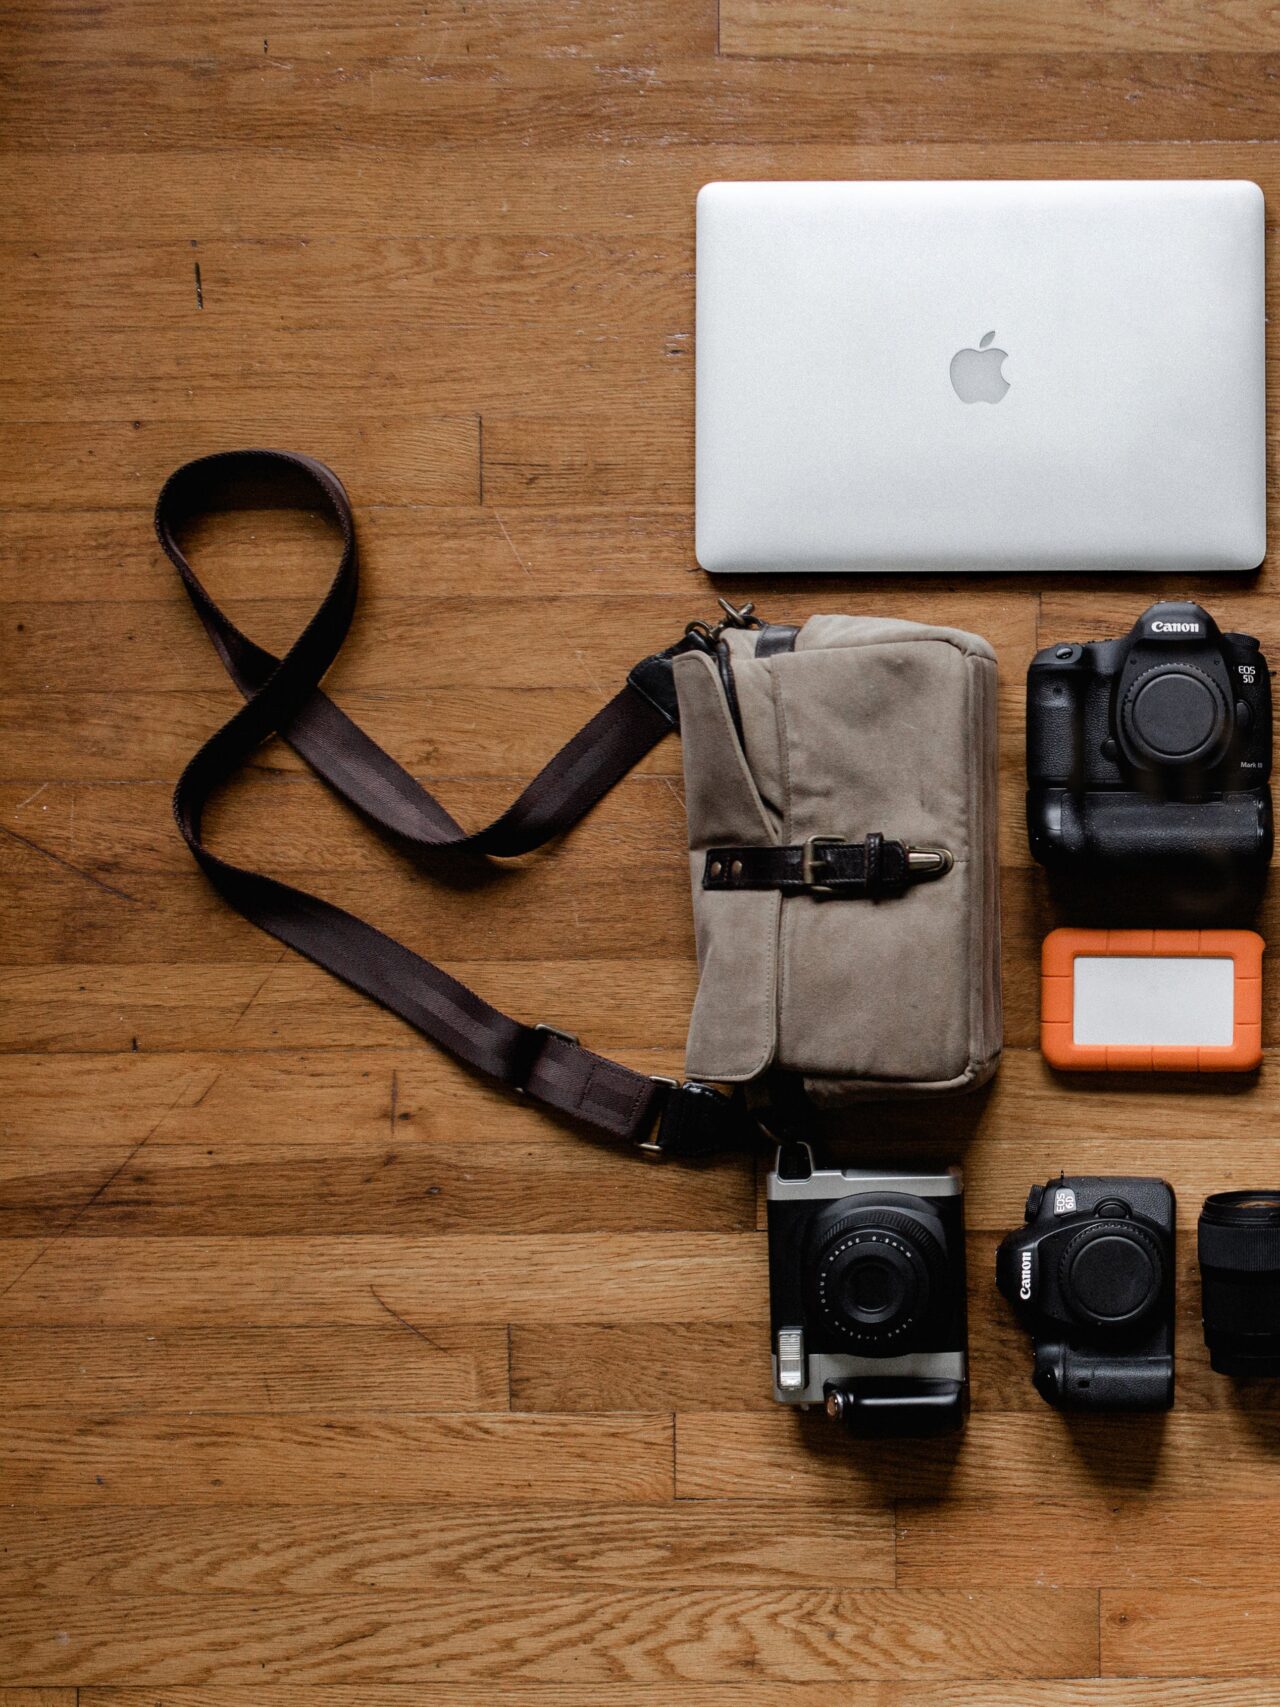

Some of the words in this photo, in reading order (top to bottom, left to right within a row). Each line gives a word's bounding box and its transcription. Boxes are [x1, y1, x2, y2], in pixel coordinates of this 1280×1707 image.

[1151, 621, 1200, 633] Canon
[1238, 665, 1256, 675] EOS
[1242, 674, 1255, 684] 5D
[1057, 1192, 1066, 1213] EOS
[1065, 1195, 1075, 1209] 6D
[1019, 1251, 1032, 1300] Canon
